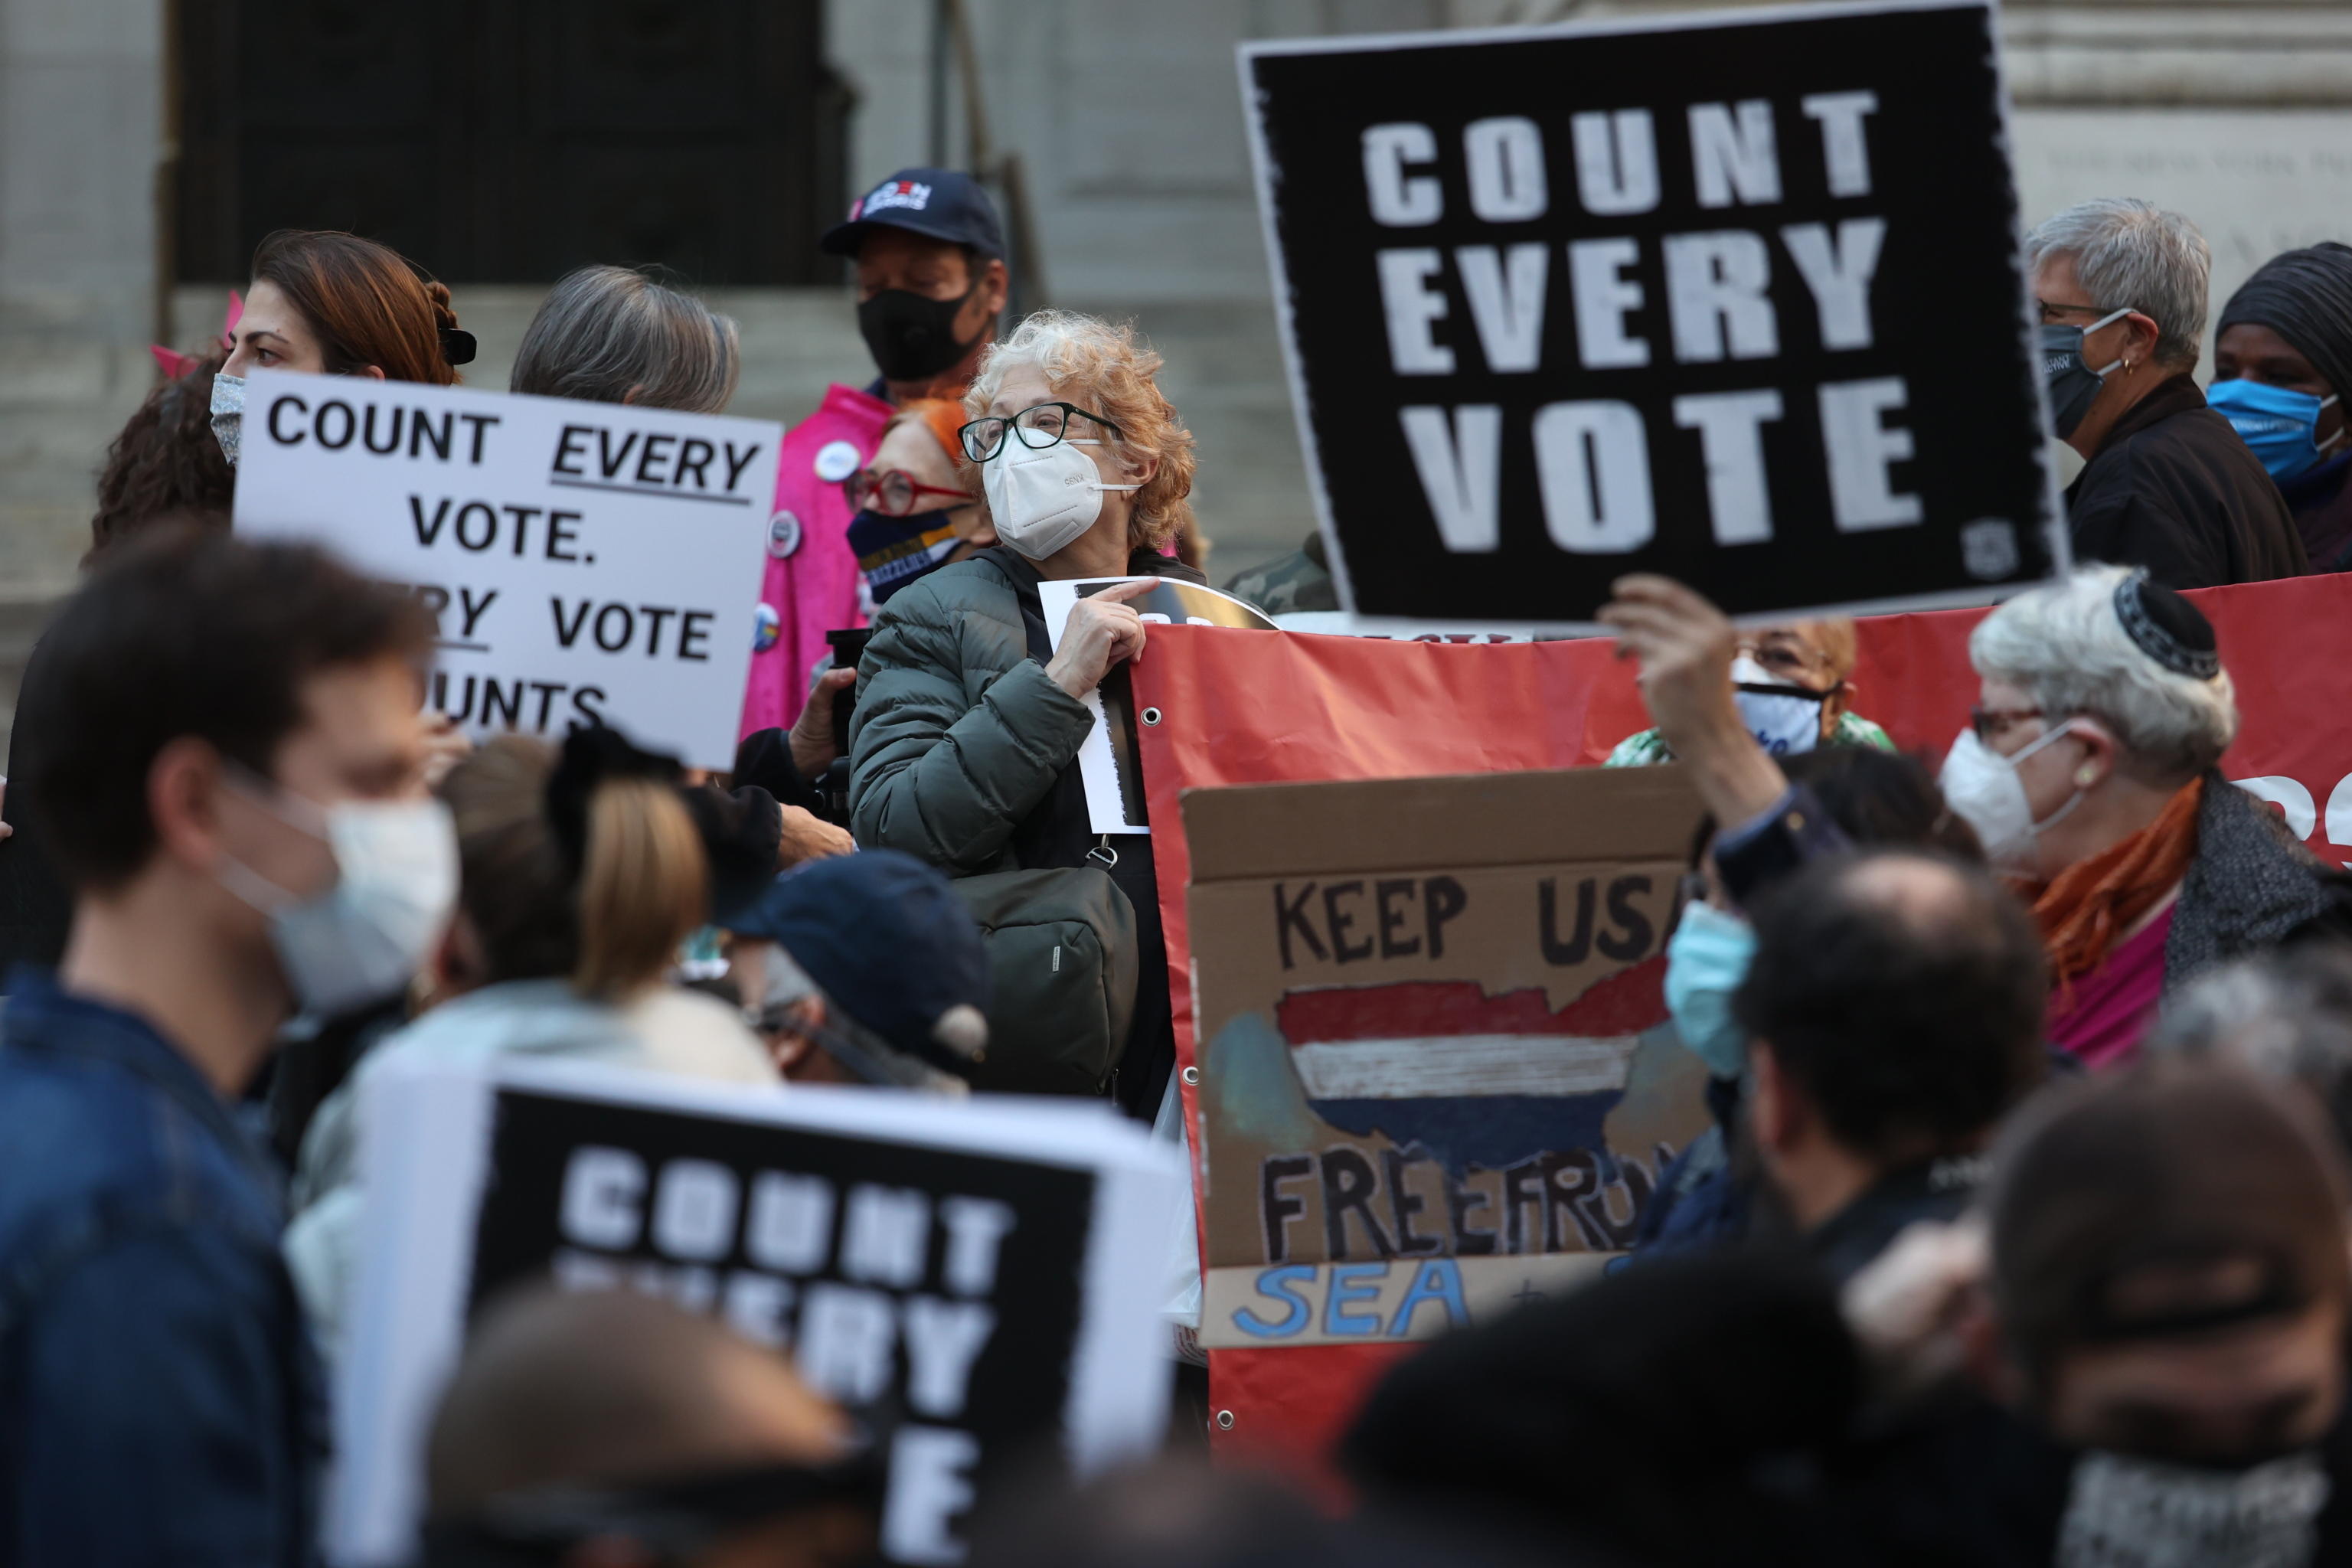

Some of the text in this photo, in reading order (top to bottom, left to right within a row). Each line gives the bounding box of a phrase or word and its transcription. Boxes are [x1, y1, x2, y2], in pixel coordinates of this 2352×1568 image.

[1361, 90, 1880, 227] COUNT
[1376, 217, 1886, 376] EVERY
[267, 394, 760, 492] COUNT EVERY
[1064, 473, 1085, 488] KN95
[1399, 377, 1923, 554] VOTE
[409, 495, 596, 564] VOTE.
[550, 597, 717, 662] VOTE
[433, 671, 607, 733] UNTS
[1273, 874, 1468, 970] KEEP
[557, 1145, 1017, 1298] COUNT
[1502, 1141, 1677, 1256] FRO
[551, 1246, 997, 1419] ERY
[1231, 1257, 1470, 1338] SEA
